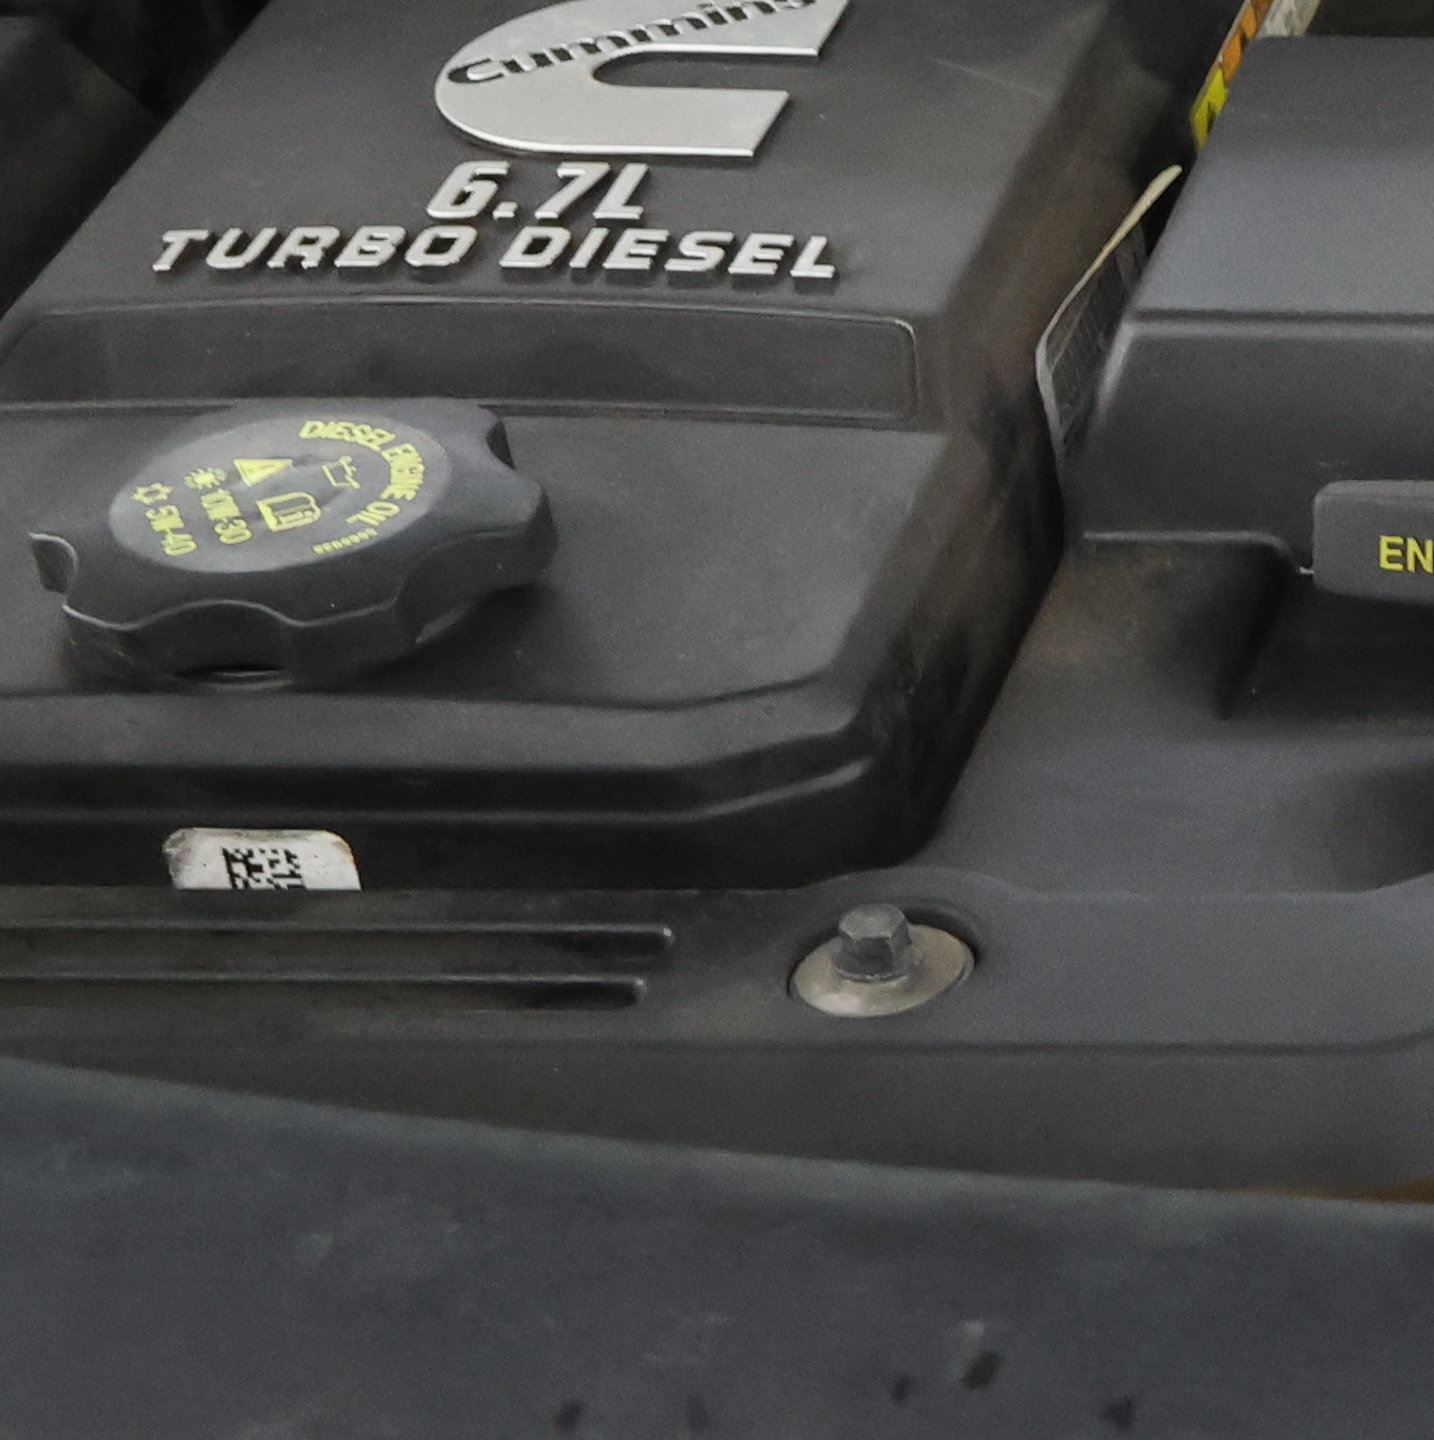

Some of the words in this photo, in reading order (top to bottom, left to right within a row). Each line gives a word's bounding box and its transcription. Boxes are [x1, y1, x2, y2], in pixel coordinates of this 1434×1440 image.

[425, 160, 650, 220] 6.7L
[153, 225, 477, 272] TURBO
[498, 224, 838, 278] DIESEL
[299, 419, 397, 452] DIESEL
[346, 500, 402, 526] OIL
